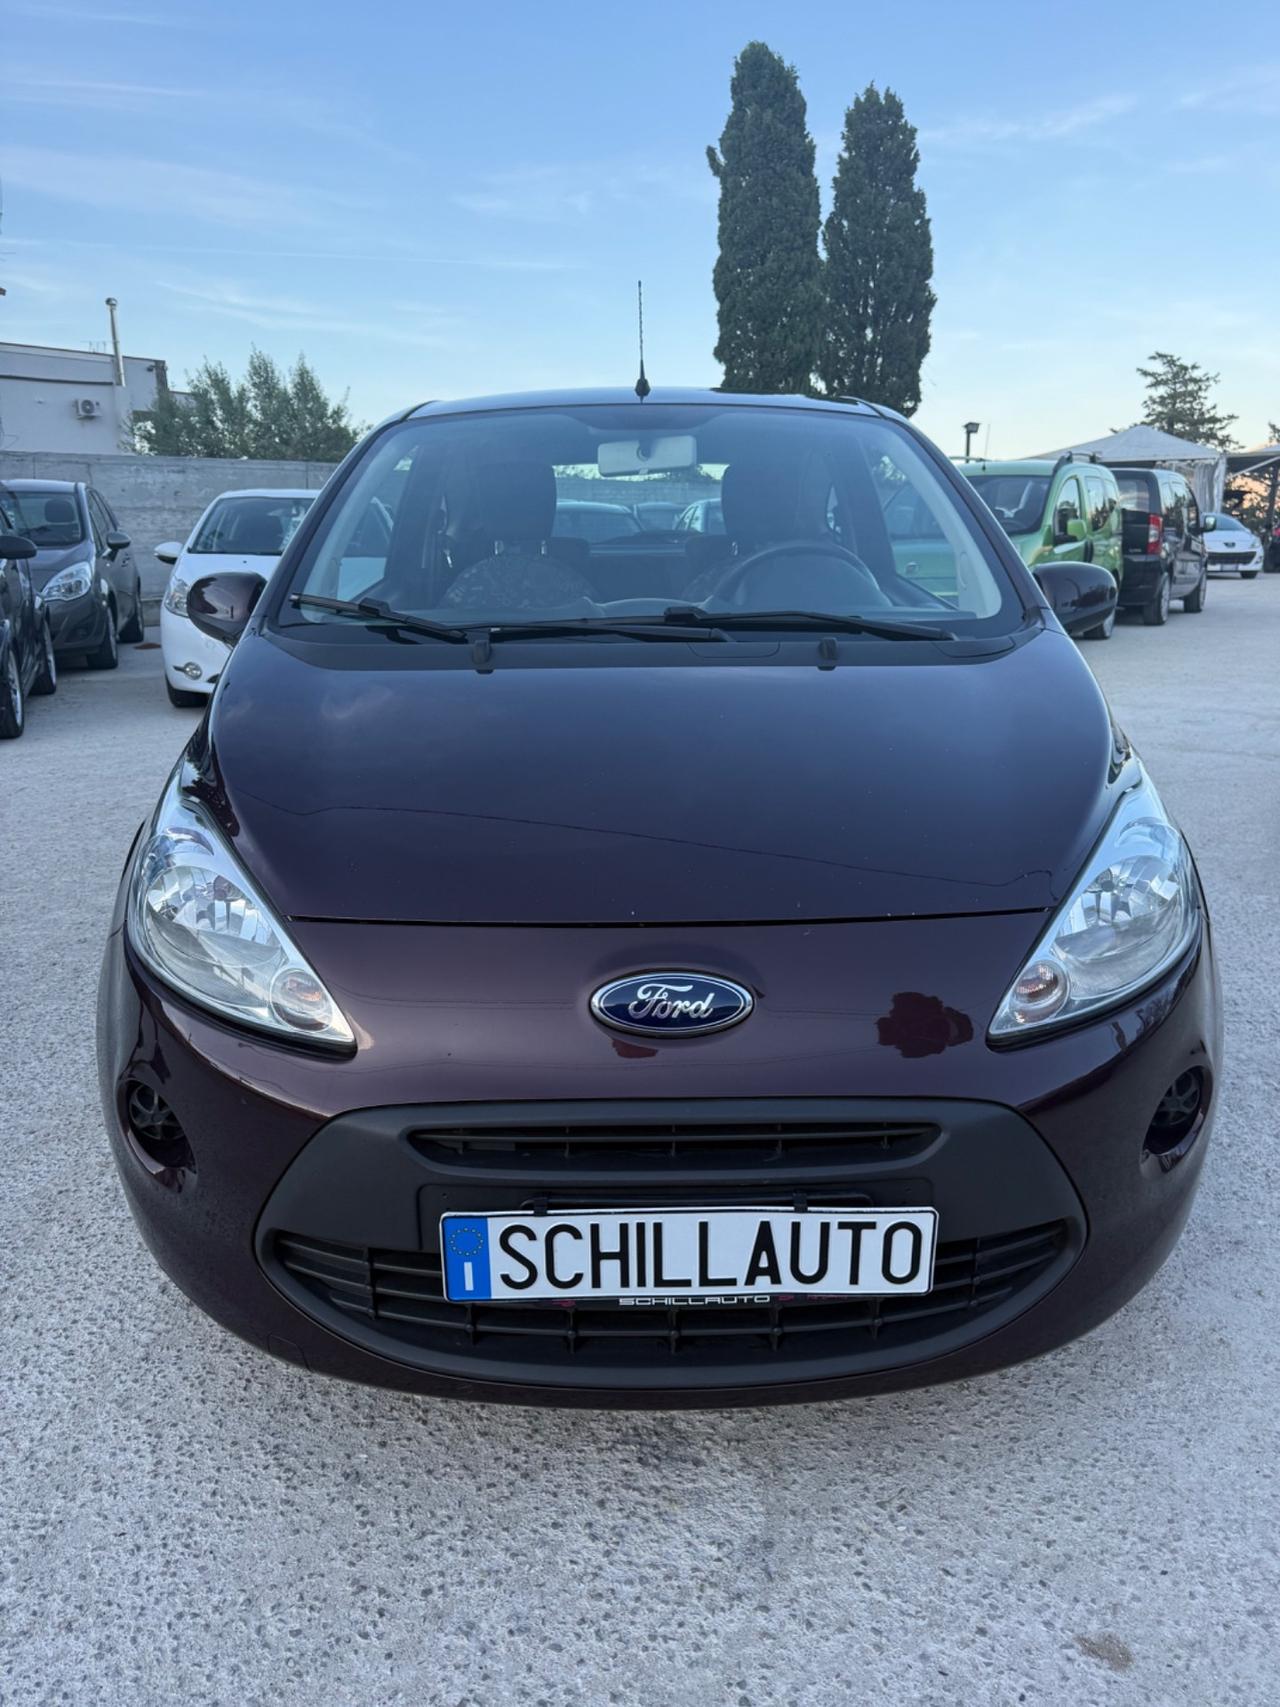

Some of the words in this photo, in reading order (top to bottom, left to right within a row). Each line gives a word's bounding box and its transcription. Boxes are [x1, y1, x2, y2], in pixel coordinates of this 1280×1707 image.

[628, 983, 715, 1019] Ford
[499, 1221, 922, 1289] SCHILLAUTO
[464, 1262, 474, 1290] I
[618, 1294, 771, 1306] SCHILLAUTO
